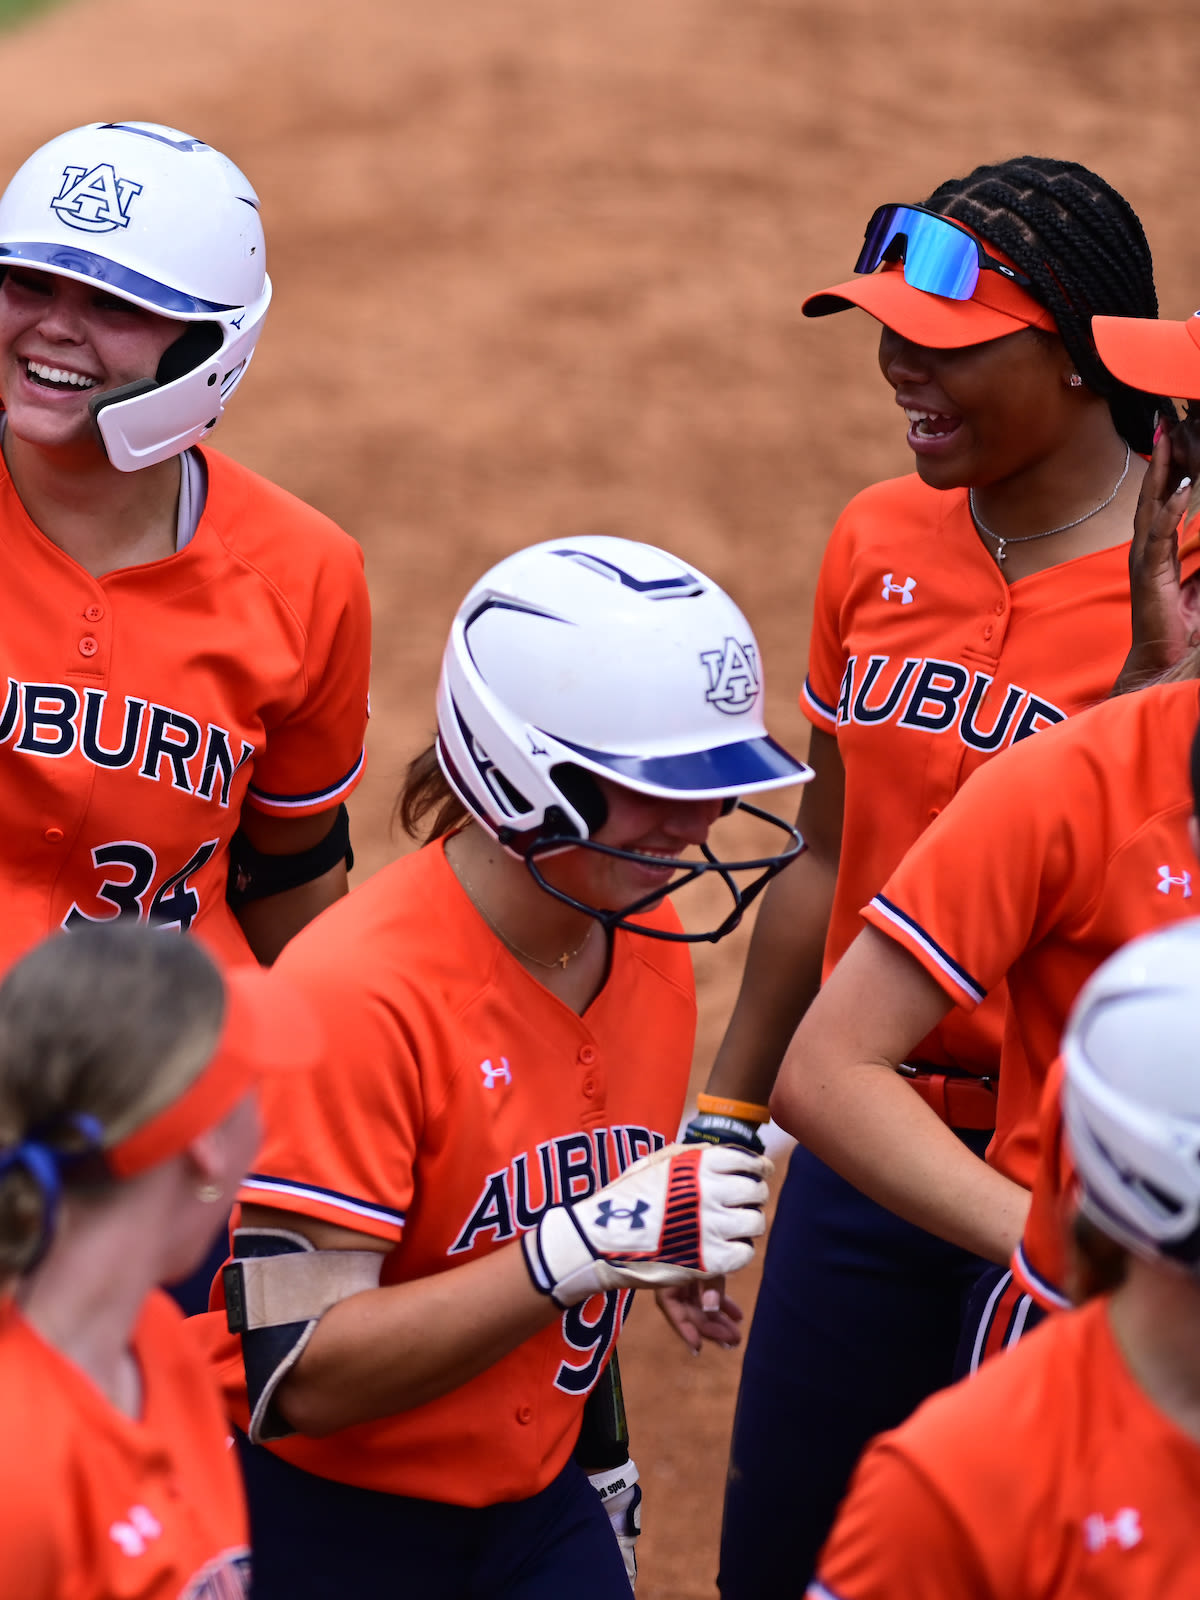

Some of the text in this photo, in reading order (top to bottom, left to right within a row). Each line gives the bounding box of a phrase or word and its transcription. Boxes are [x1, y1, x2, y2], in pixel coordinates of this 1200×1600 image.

[61, 838, 220, 935] 34
[446, 1124, 666, 1256] AUBUR
[552, 1286, 637, 1396] 9
